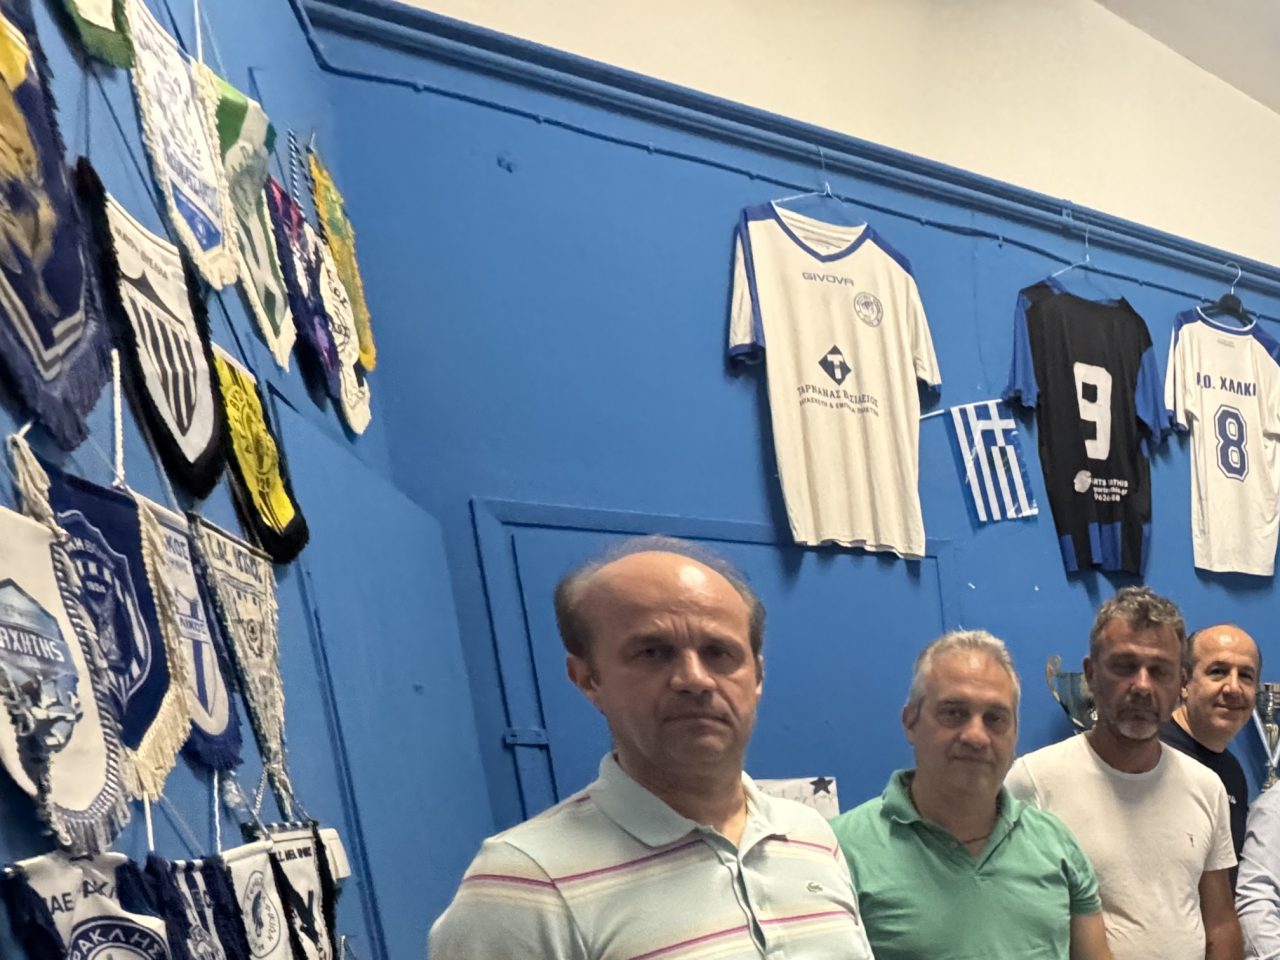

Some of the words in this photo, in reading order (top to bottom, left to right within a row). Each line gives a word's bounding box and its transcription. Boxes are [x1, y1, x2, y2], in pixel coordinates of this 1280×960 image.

[802, 272, 854, 286] GIVOVA
[1073, 361, 1112, 460] 9
[1214, 404, 1249, 482] 8
